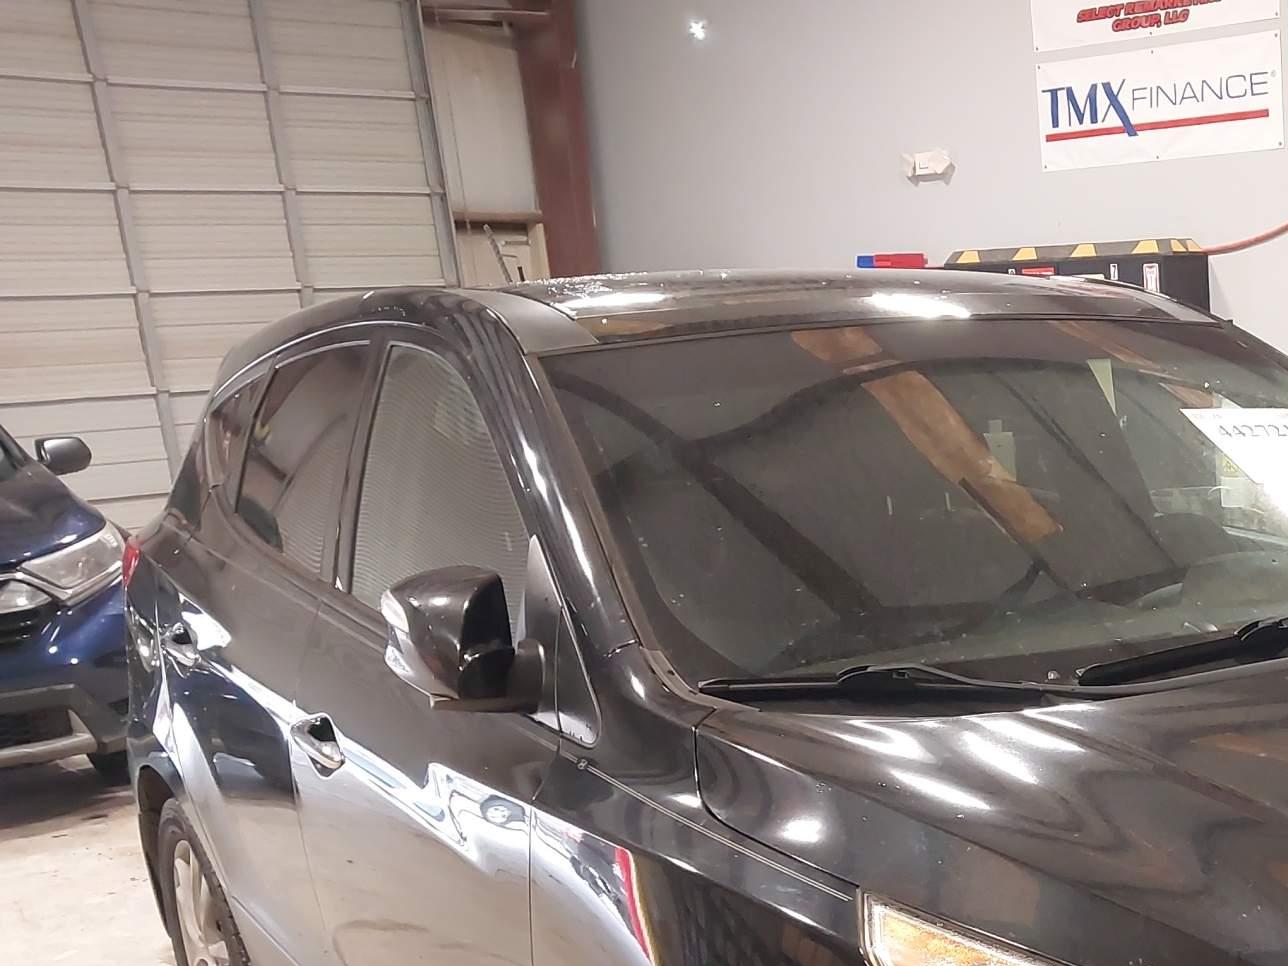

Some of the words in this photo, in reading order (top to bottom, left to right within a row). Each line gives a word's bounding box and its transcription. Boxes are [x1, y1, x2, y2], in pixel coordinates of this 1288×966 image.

[1077, 4, 1124, 23] SELECT
[1112, 13, 1162, 32] GROUP,
[1163, 9, 1190, 25] LLC
[1041, 79, 1138, 137] TMX
[1132, 72, 1268, 111] FINANCE
